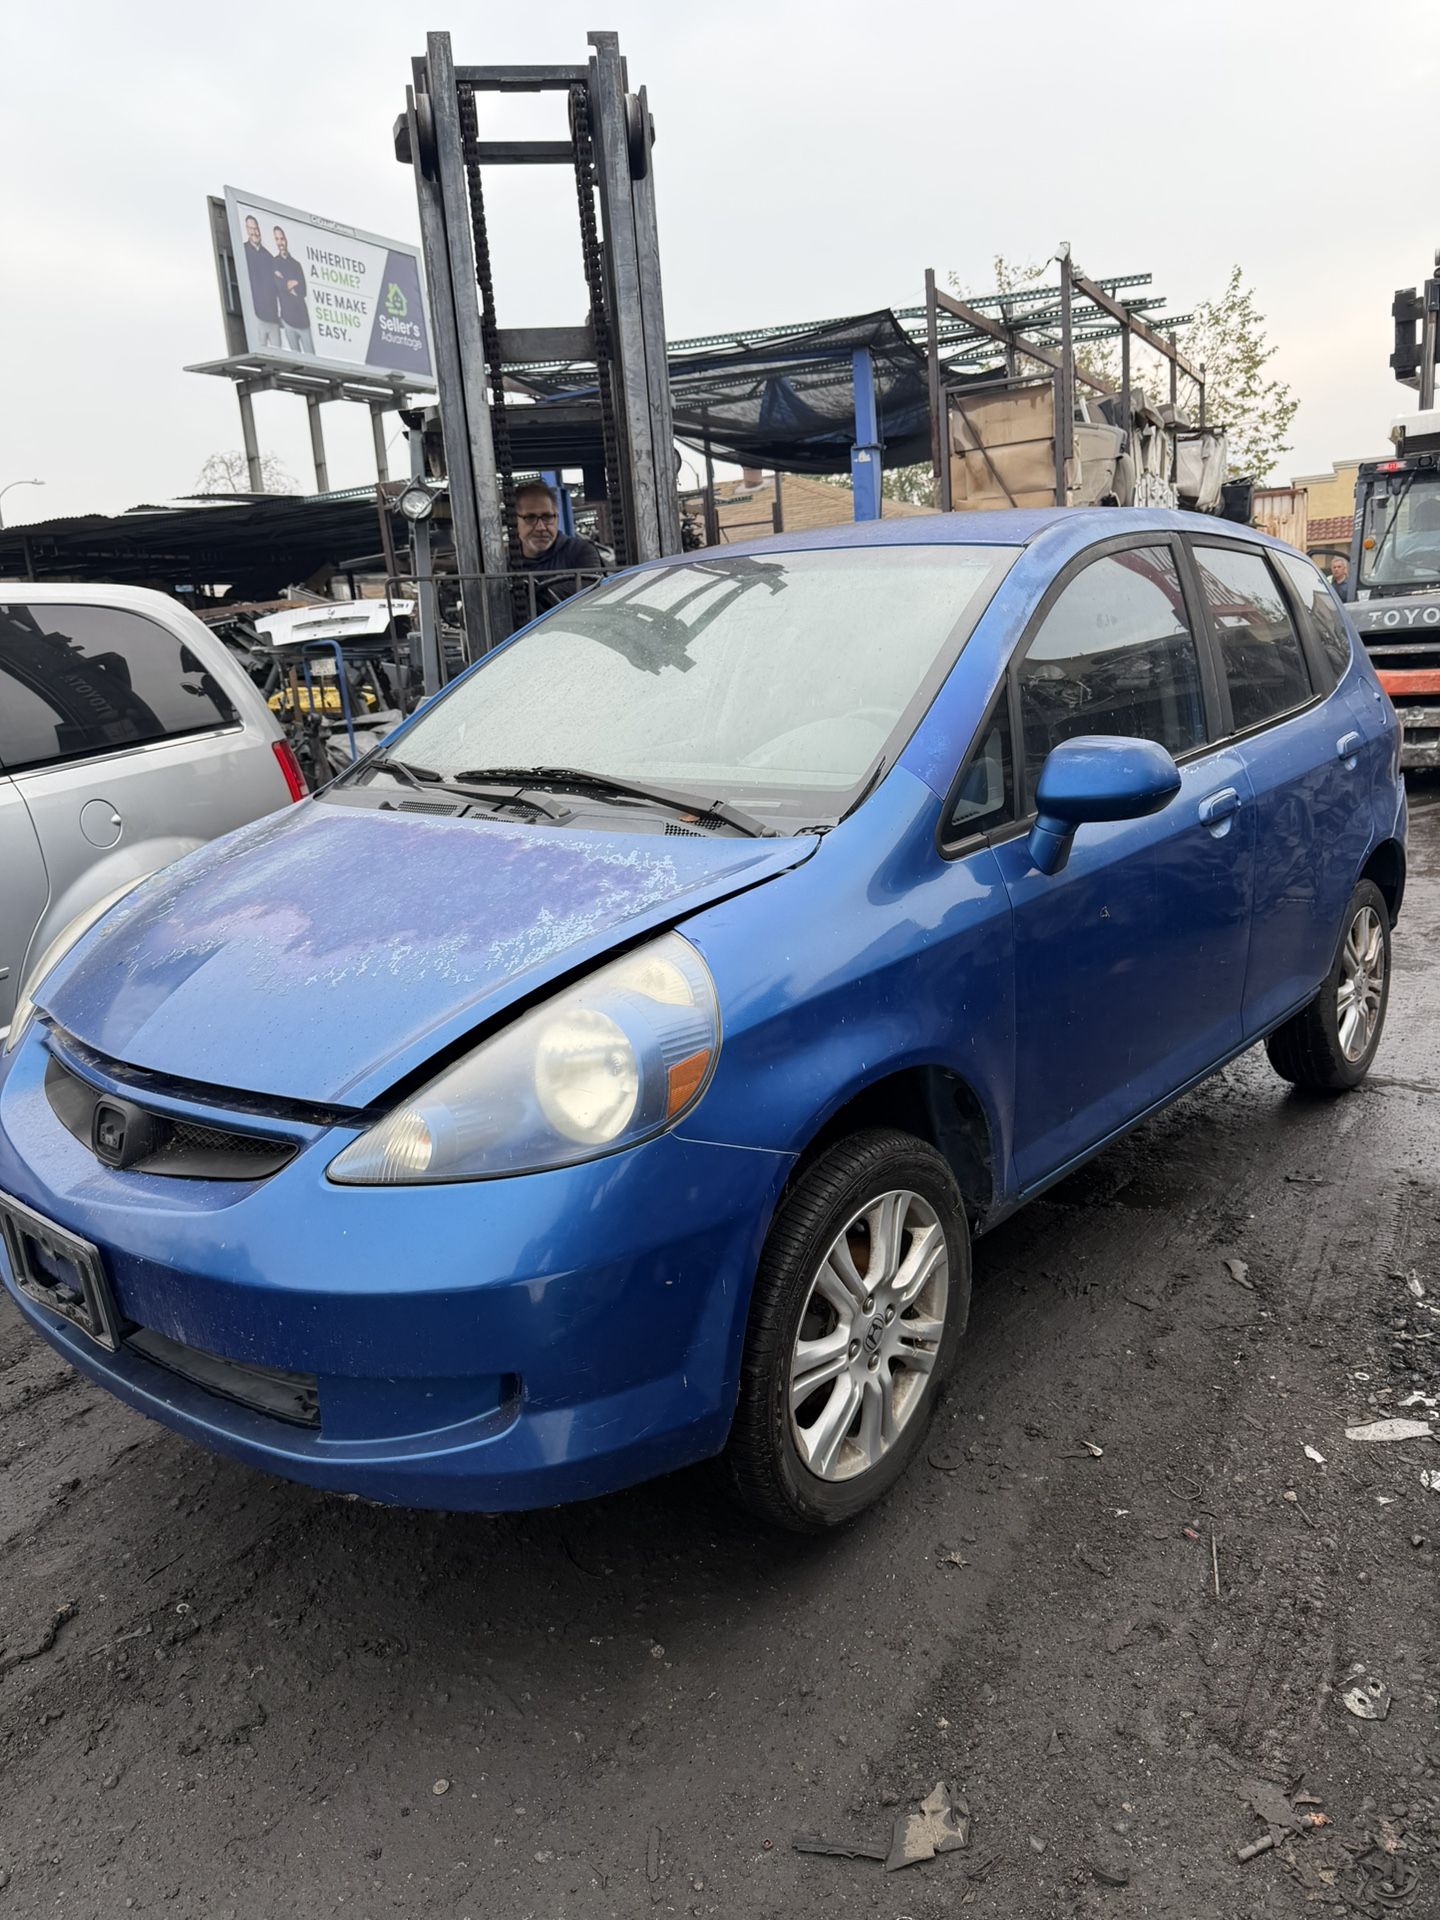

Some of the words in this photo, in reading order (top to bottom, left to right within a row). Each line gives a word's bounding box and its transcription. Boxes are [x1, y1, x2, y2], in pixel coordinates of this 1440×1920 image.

[306, 246, 366, 274] INHERITED
[311, 264, 319, 278] A
[321, 267, 361, 289] HOME?
[313, 289, 332, 306] WE
[334, 295, 367, 315] MAKE
[315, 306, 361, 328] SELLING
[379, 314, 420, 337] Seller's
[318, 323, 352, 342] EASY.
[381, 331, 422, 351] Advantage
